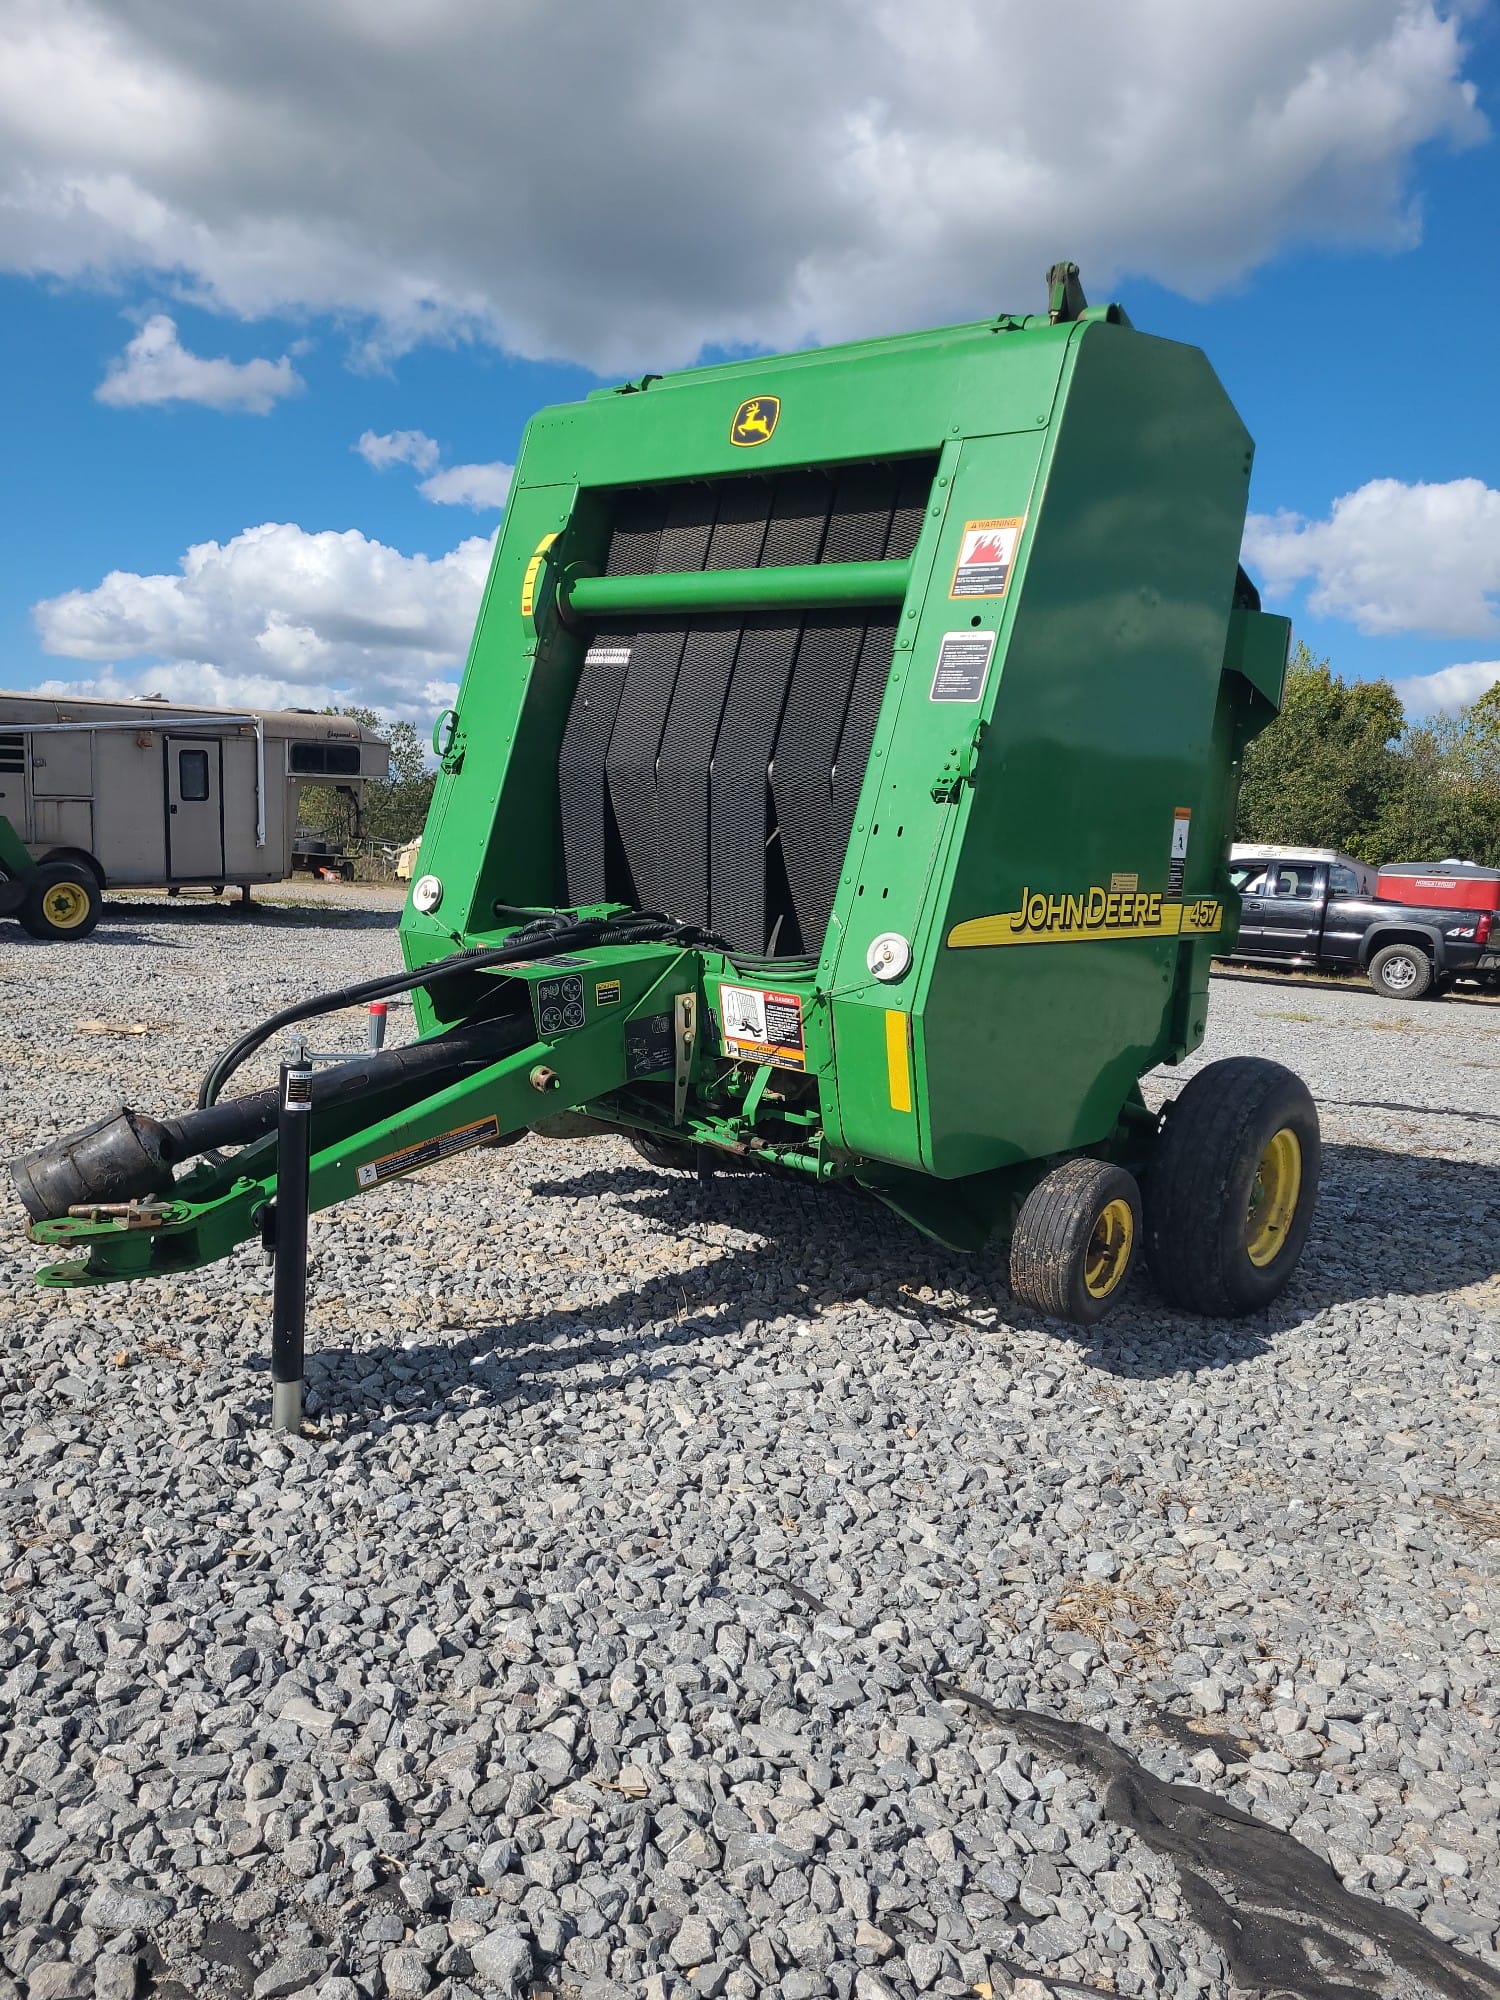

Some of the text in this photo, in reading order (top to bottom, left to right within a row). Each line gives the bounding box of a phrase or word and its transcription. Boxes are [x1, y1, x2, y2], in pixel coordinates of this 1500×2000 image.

[978, 518, 1017, 529] WARNING
[1010, 886, 1162, 930] JOHN DEERE
[1190, 900, 1218, 926] 457
